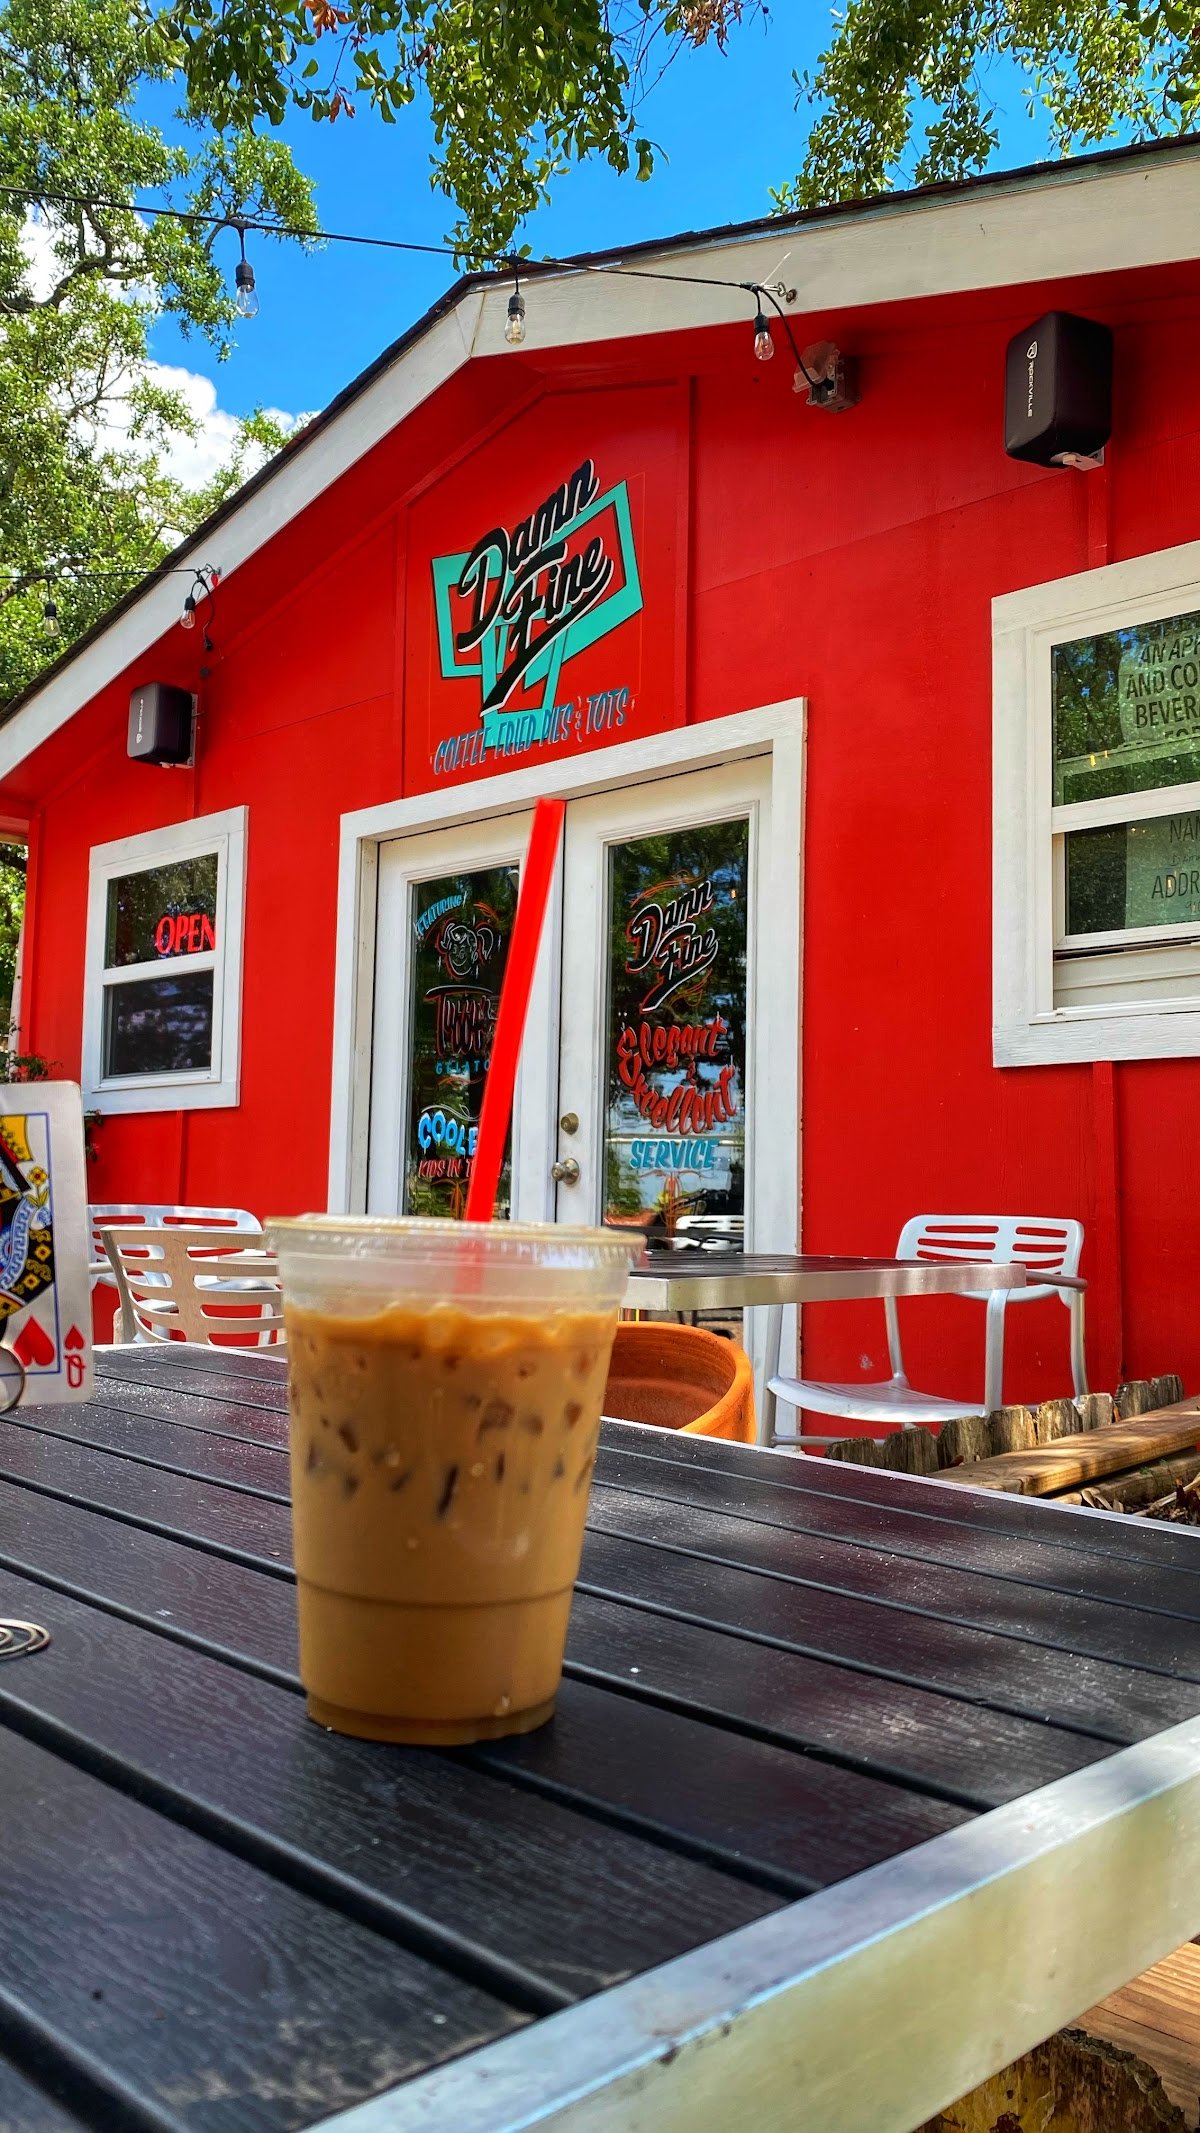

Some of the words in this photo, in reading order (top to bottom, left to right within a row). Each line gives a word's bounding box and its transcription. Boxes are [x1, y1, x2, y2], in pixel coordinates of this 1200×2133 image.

[457, 458, 600, 653] Damn
[480, 537, 614, 717] Fine
[1126, 670, 1165, 699] AND
[1171, 661, 1200, 690] CO
[1135, 695, 1200, 728] BEVER
[433, 727, 492, 775] COFFEE
[494, 713, 537, 759] FRIED
[539, 703, 574, 747] PIES
[585, 687, 630, 734] TOTS
[155, 914, 216, 955] OPEN
[624, 879, 715, 975] Damn
[639, 921, 719, 1015] Fine
[616, 1017, 728, 1087] Elegant
[418, 1159, 446, 1178] KIDS
[447, 1158, 461, 1178] IN
[629, 1138, 720, 1170] SERVICE
